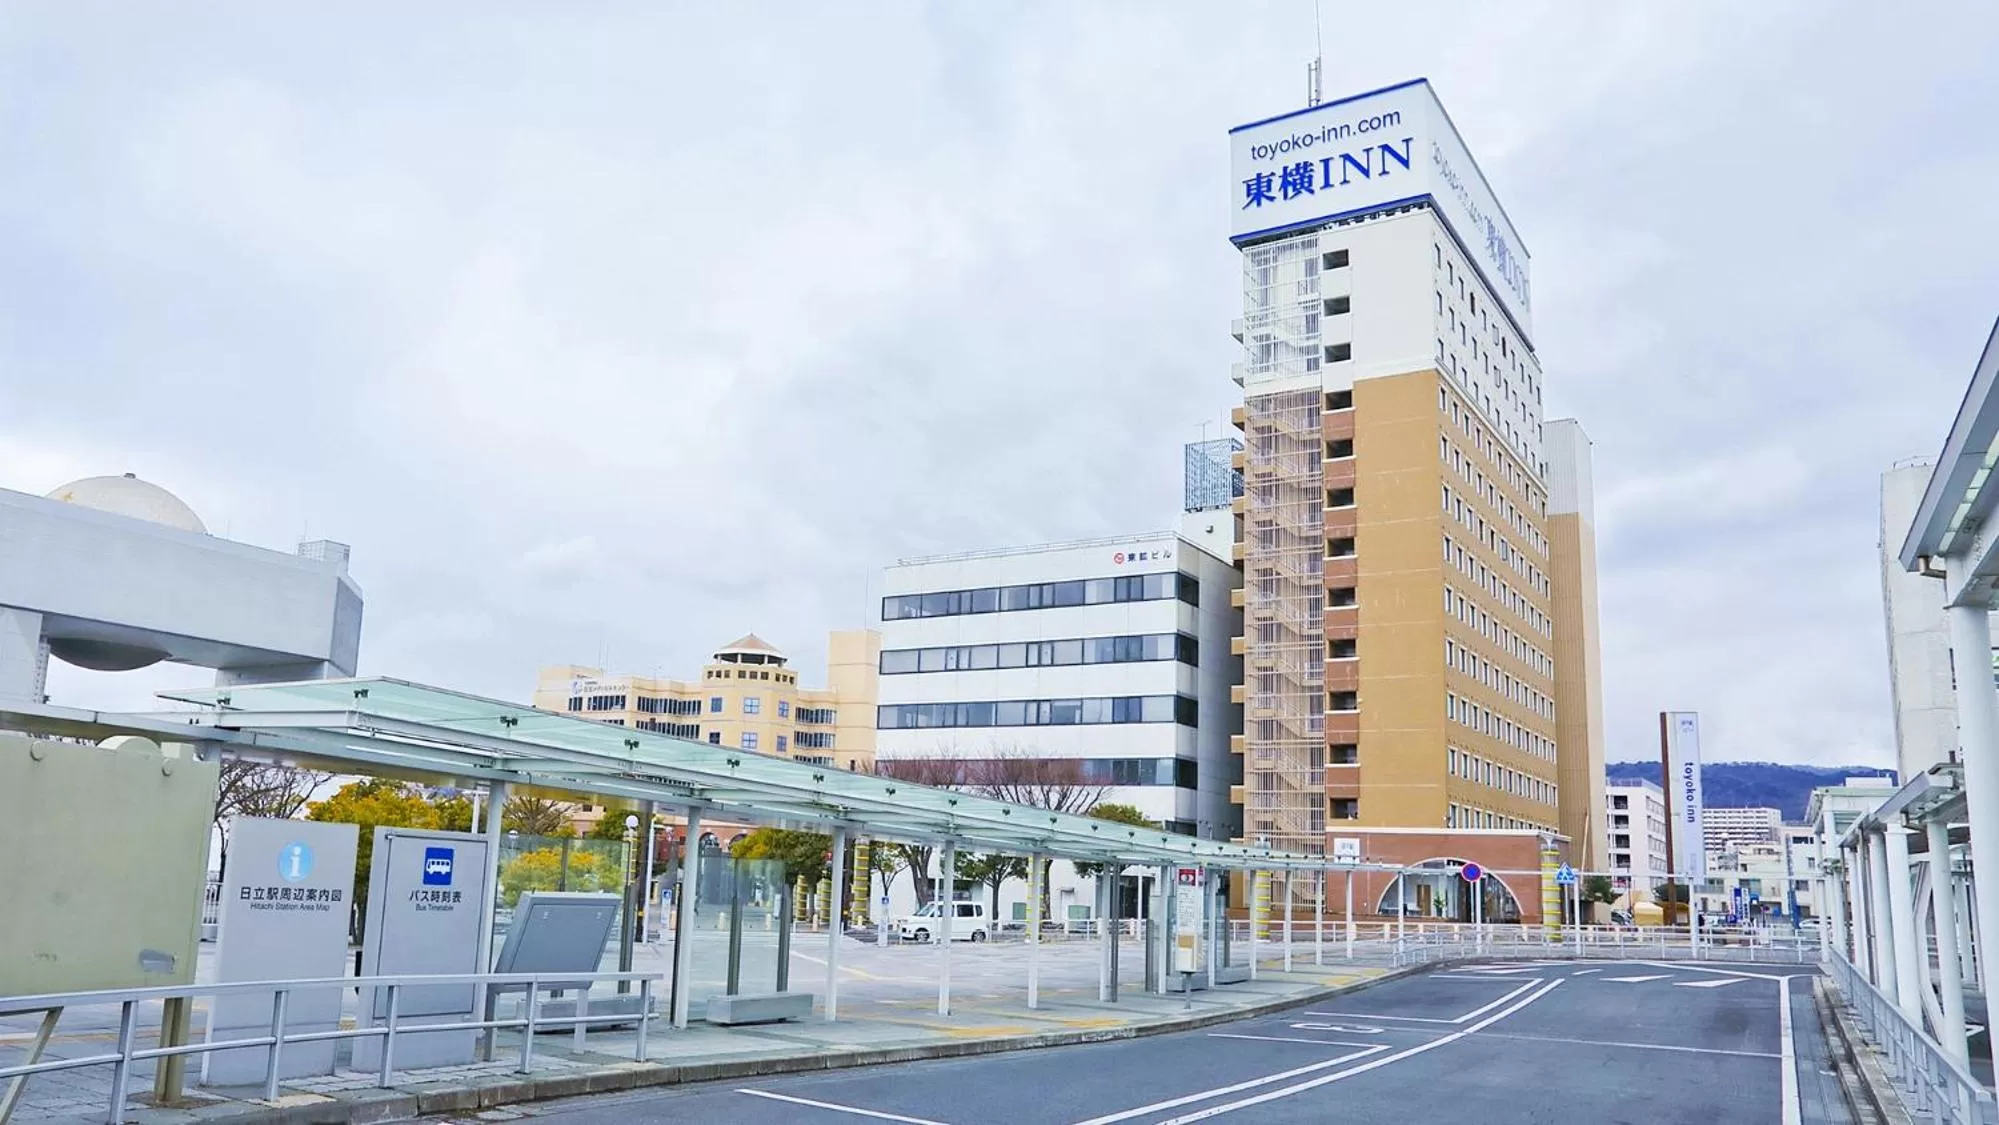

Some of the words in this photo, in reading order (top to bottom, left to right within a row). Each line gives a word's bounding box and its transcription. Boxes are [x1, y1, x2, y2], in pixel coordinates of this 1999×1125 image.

[1251, 110, 1401, 160] toyoko-inn.com
[1242, 137, 1414, 210] 東横INN
[1683, 762, 1696, 802] toyoko
[1687, 804, 1698, 823] inn
[240, 886, 342, 902] 日立駅周辺案内図
[409, 890, 462, 903] バス時刻表
[250, 902, 274, 910] Hitachi
[275, 902, 298, 910] Station
[299, 903, 315, 911] Area
[316, 903, 330, 912] Map
